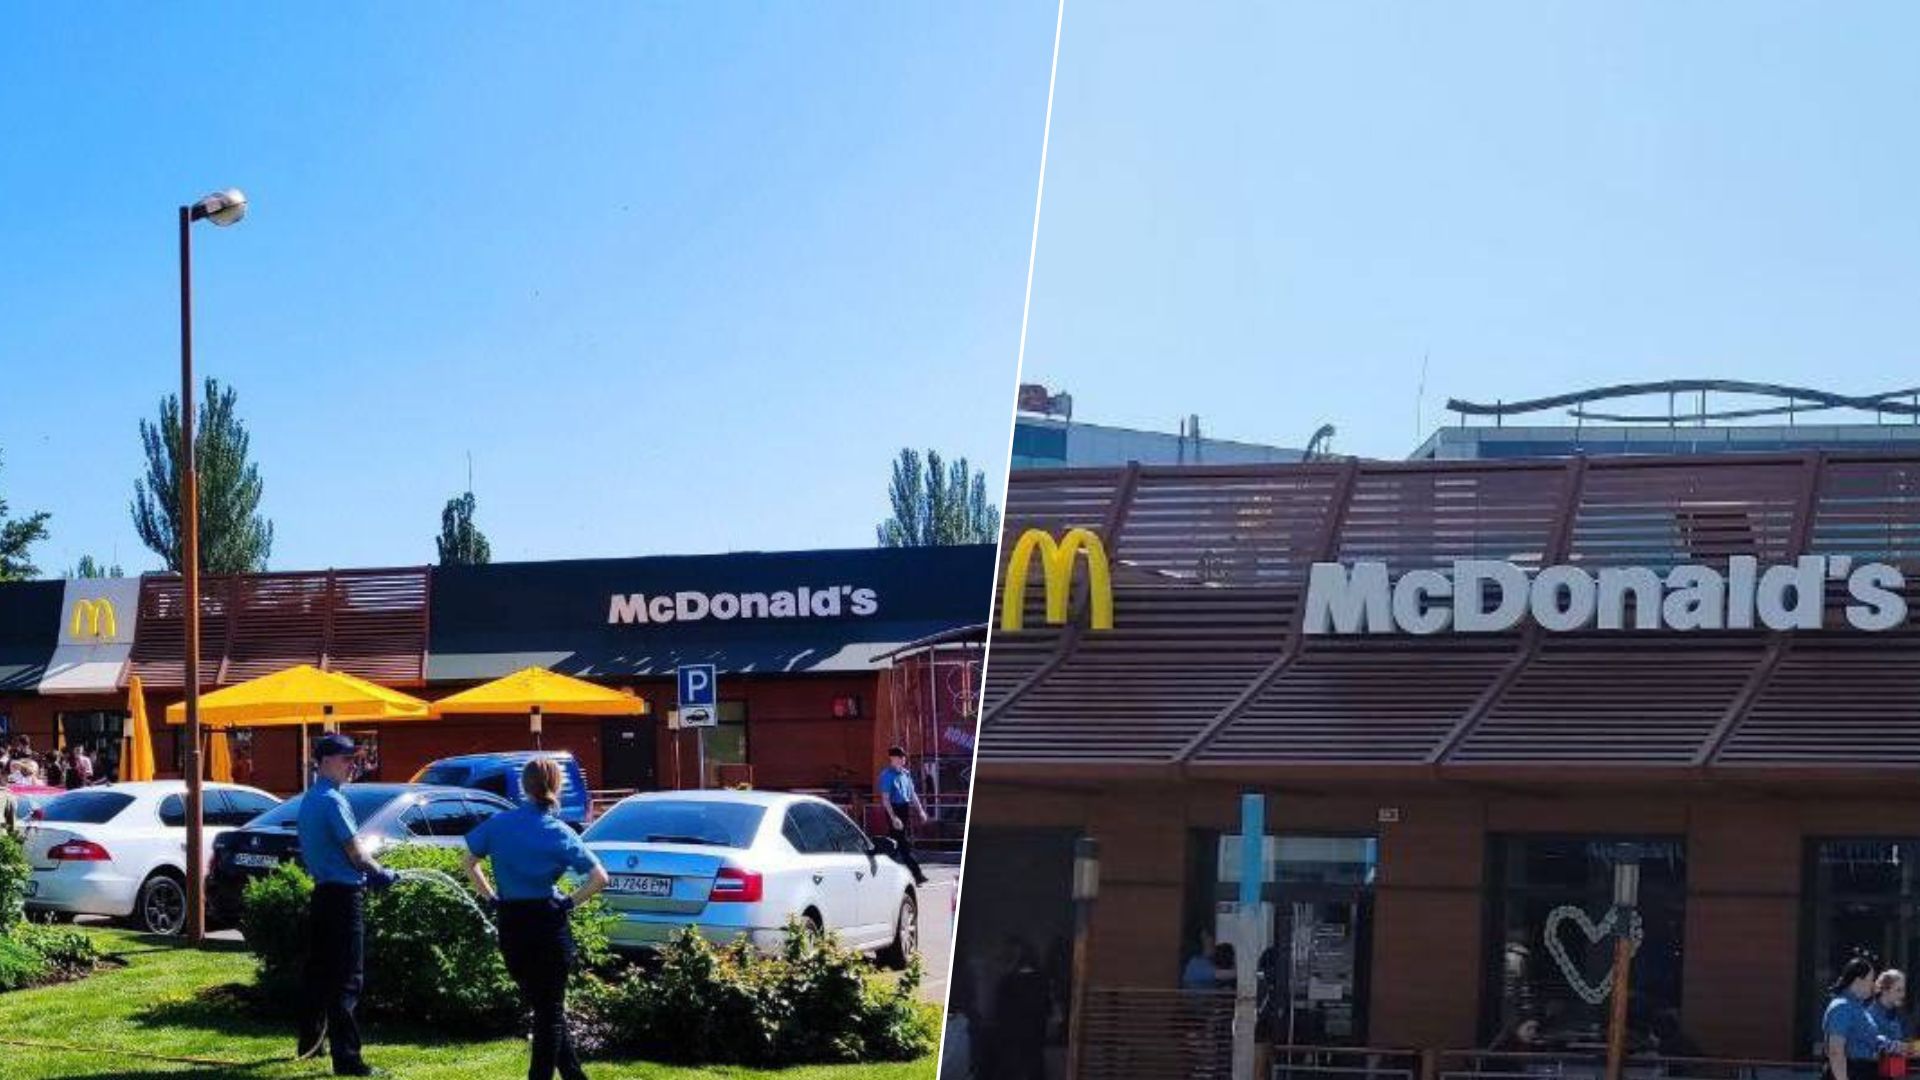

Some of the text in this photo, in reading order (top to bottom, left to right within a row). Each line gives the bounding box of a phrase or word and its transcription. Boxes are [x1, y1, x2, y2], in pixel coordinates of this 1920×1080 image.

[608, 585, 878, 624] McDonald's
[1303, 554, 1908, 635] McDonald's
[688, 669, 708, 702] P
[623, 878, 649, 891] 7246
